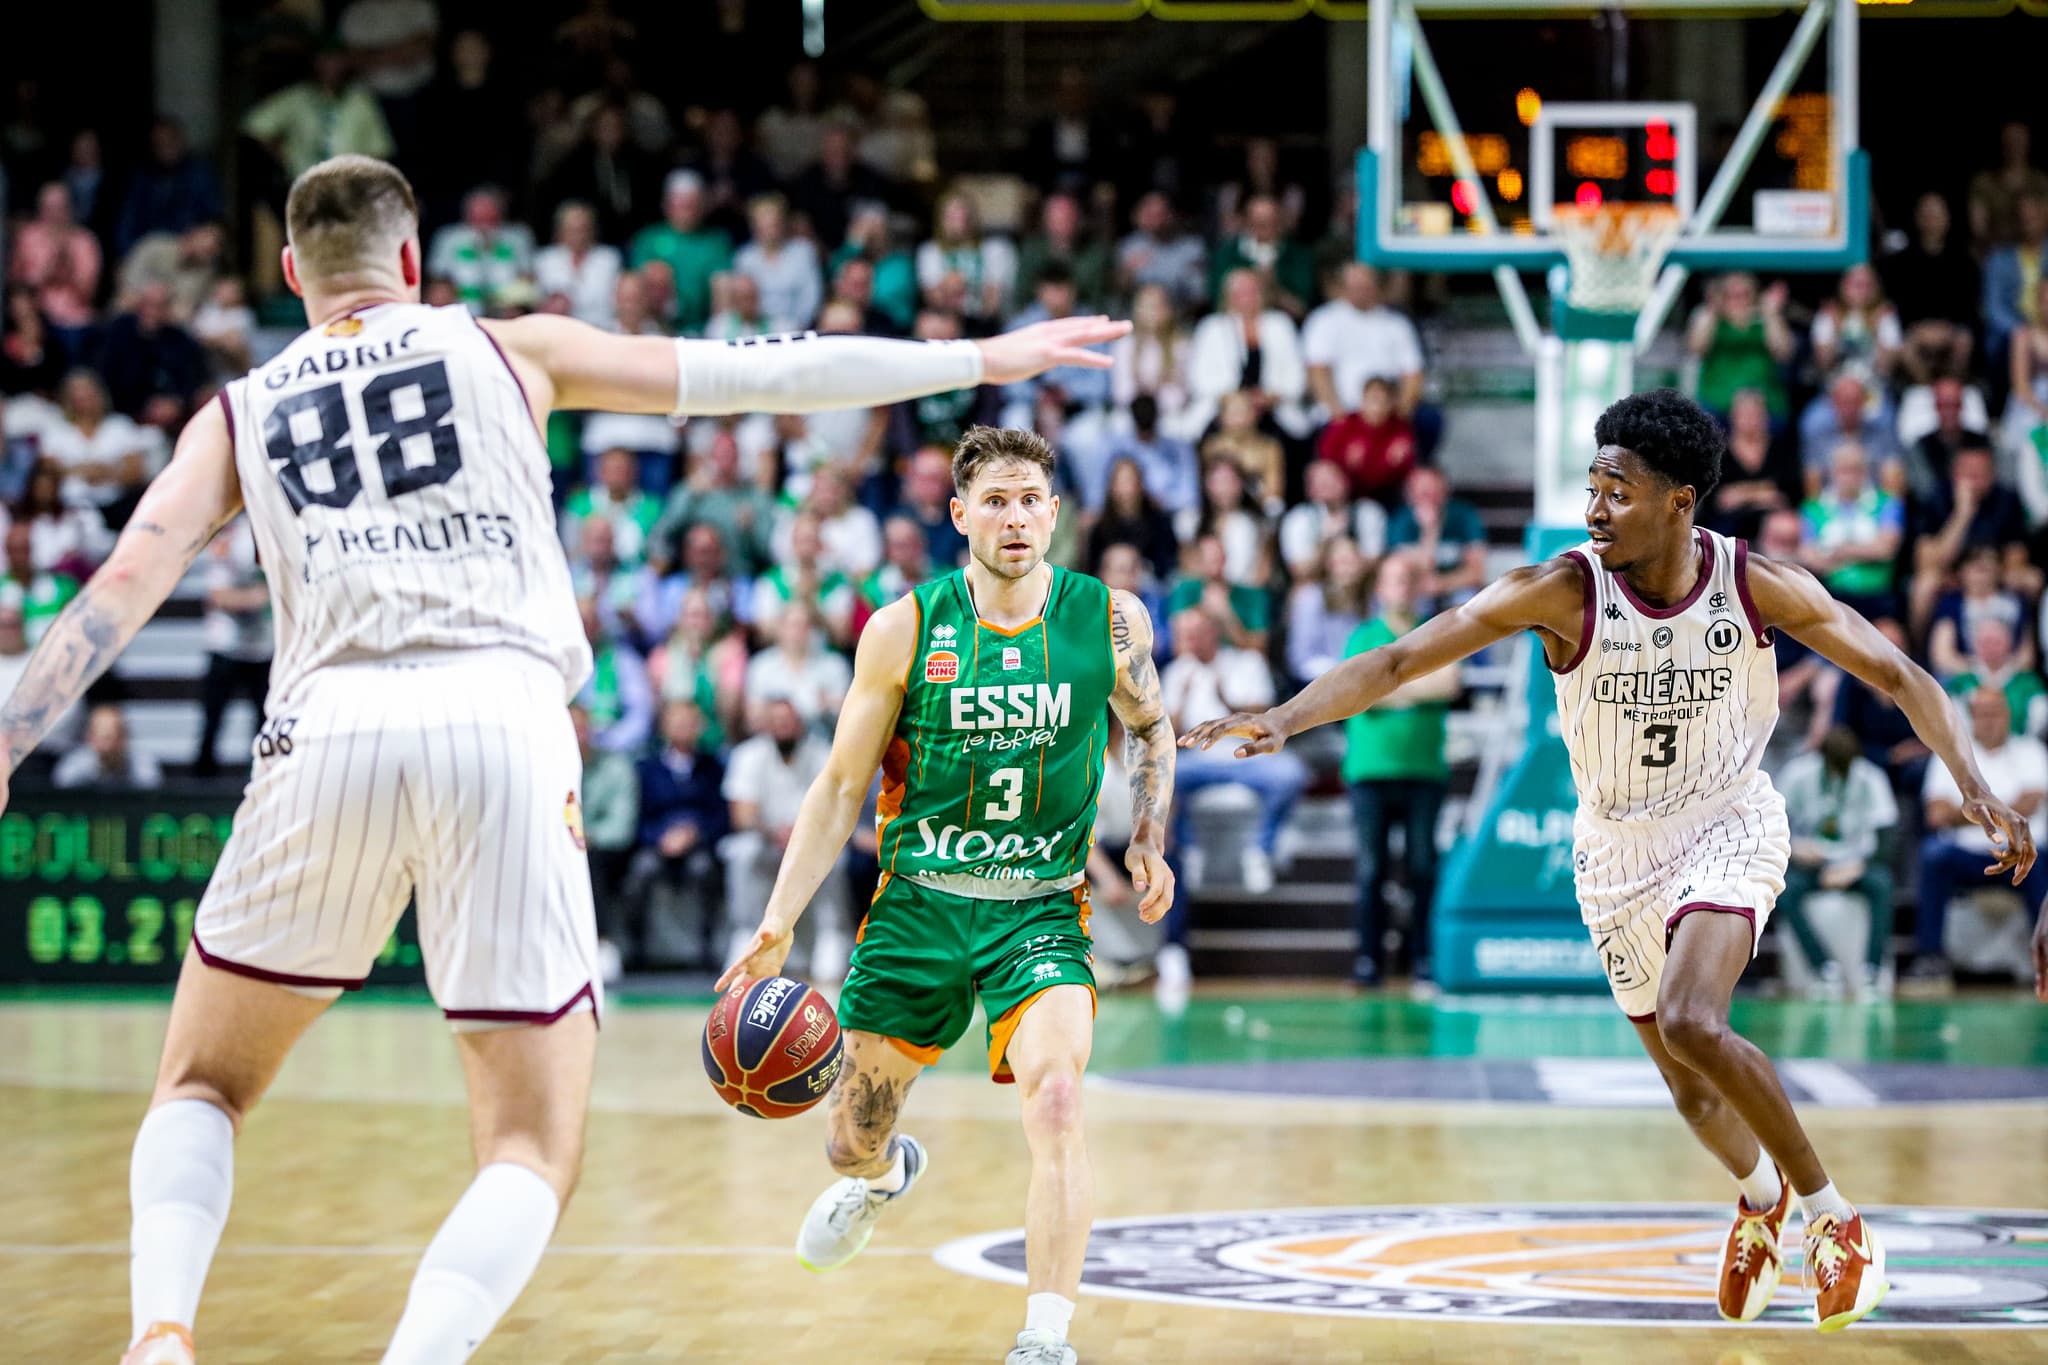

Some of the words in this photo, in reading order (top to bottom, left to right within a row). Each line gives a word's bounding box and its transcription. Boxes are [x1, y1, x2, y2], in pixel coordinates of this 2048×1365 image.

[264, 360, 462, 517] 88
[1714, 628, 1732, 648] U
[927, 667, 957, 676] KING
[1594, 659, 1732, 705] ORLÉANS
[951, 683, 1071, 730] ESSM
[1623, 706, 1704, 723] MÉTROPOLE
[1641, 724, 1678, 767] 3
[985, 767, 1024, 822] 3
